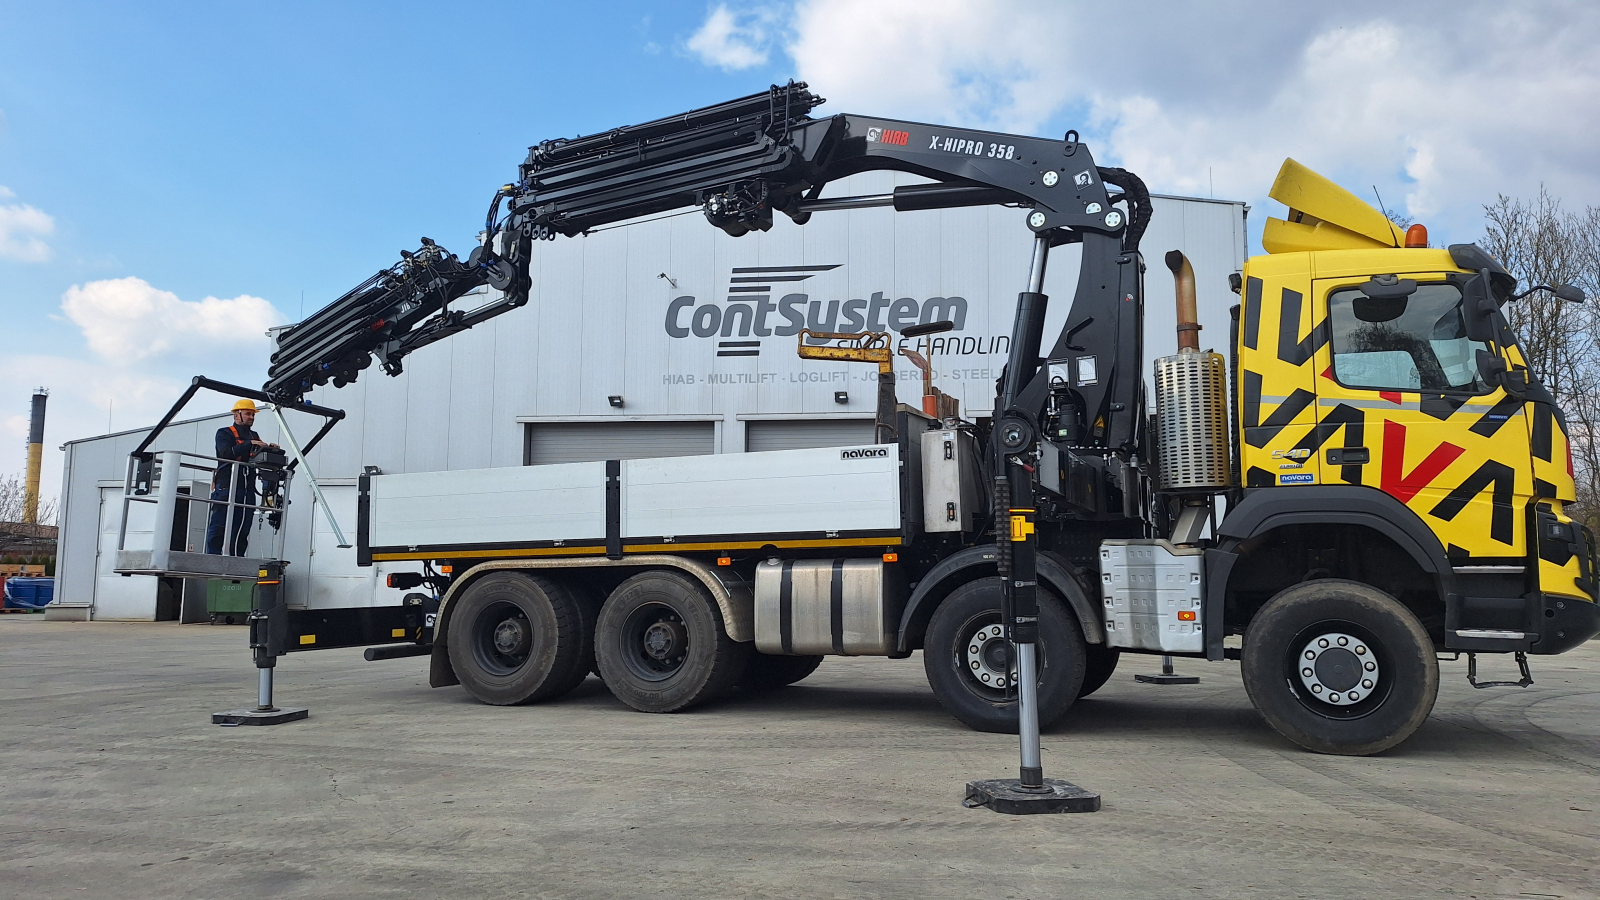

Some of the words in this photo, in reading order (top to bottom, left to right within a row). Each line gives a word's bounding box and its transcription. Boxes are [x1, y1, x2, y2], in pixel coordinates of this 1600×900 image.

[881, 129, 910, 146] HIAB
[929, 135, 984, 156] X-HIPRO
[987, 143, 1015, 160] 358
[665, 291, 968, 345] ContSystem
[837, 338, 909, 356] SIMPE
[916, 336, 1010, 355] HANDLIN
[662, 374, 695, 385] HIAB
[707, 373, 778, 385] MULTILIFT
[789, 371, 849, 383] LOGLIFT
[861, 370, 938, 382] JOSERD
[952, 368, 1003, 380] STEEL
[1271, 449, 1310, 459] 540
